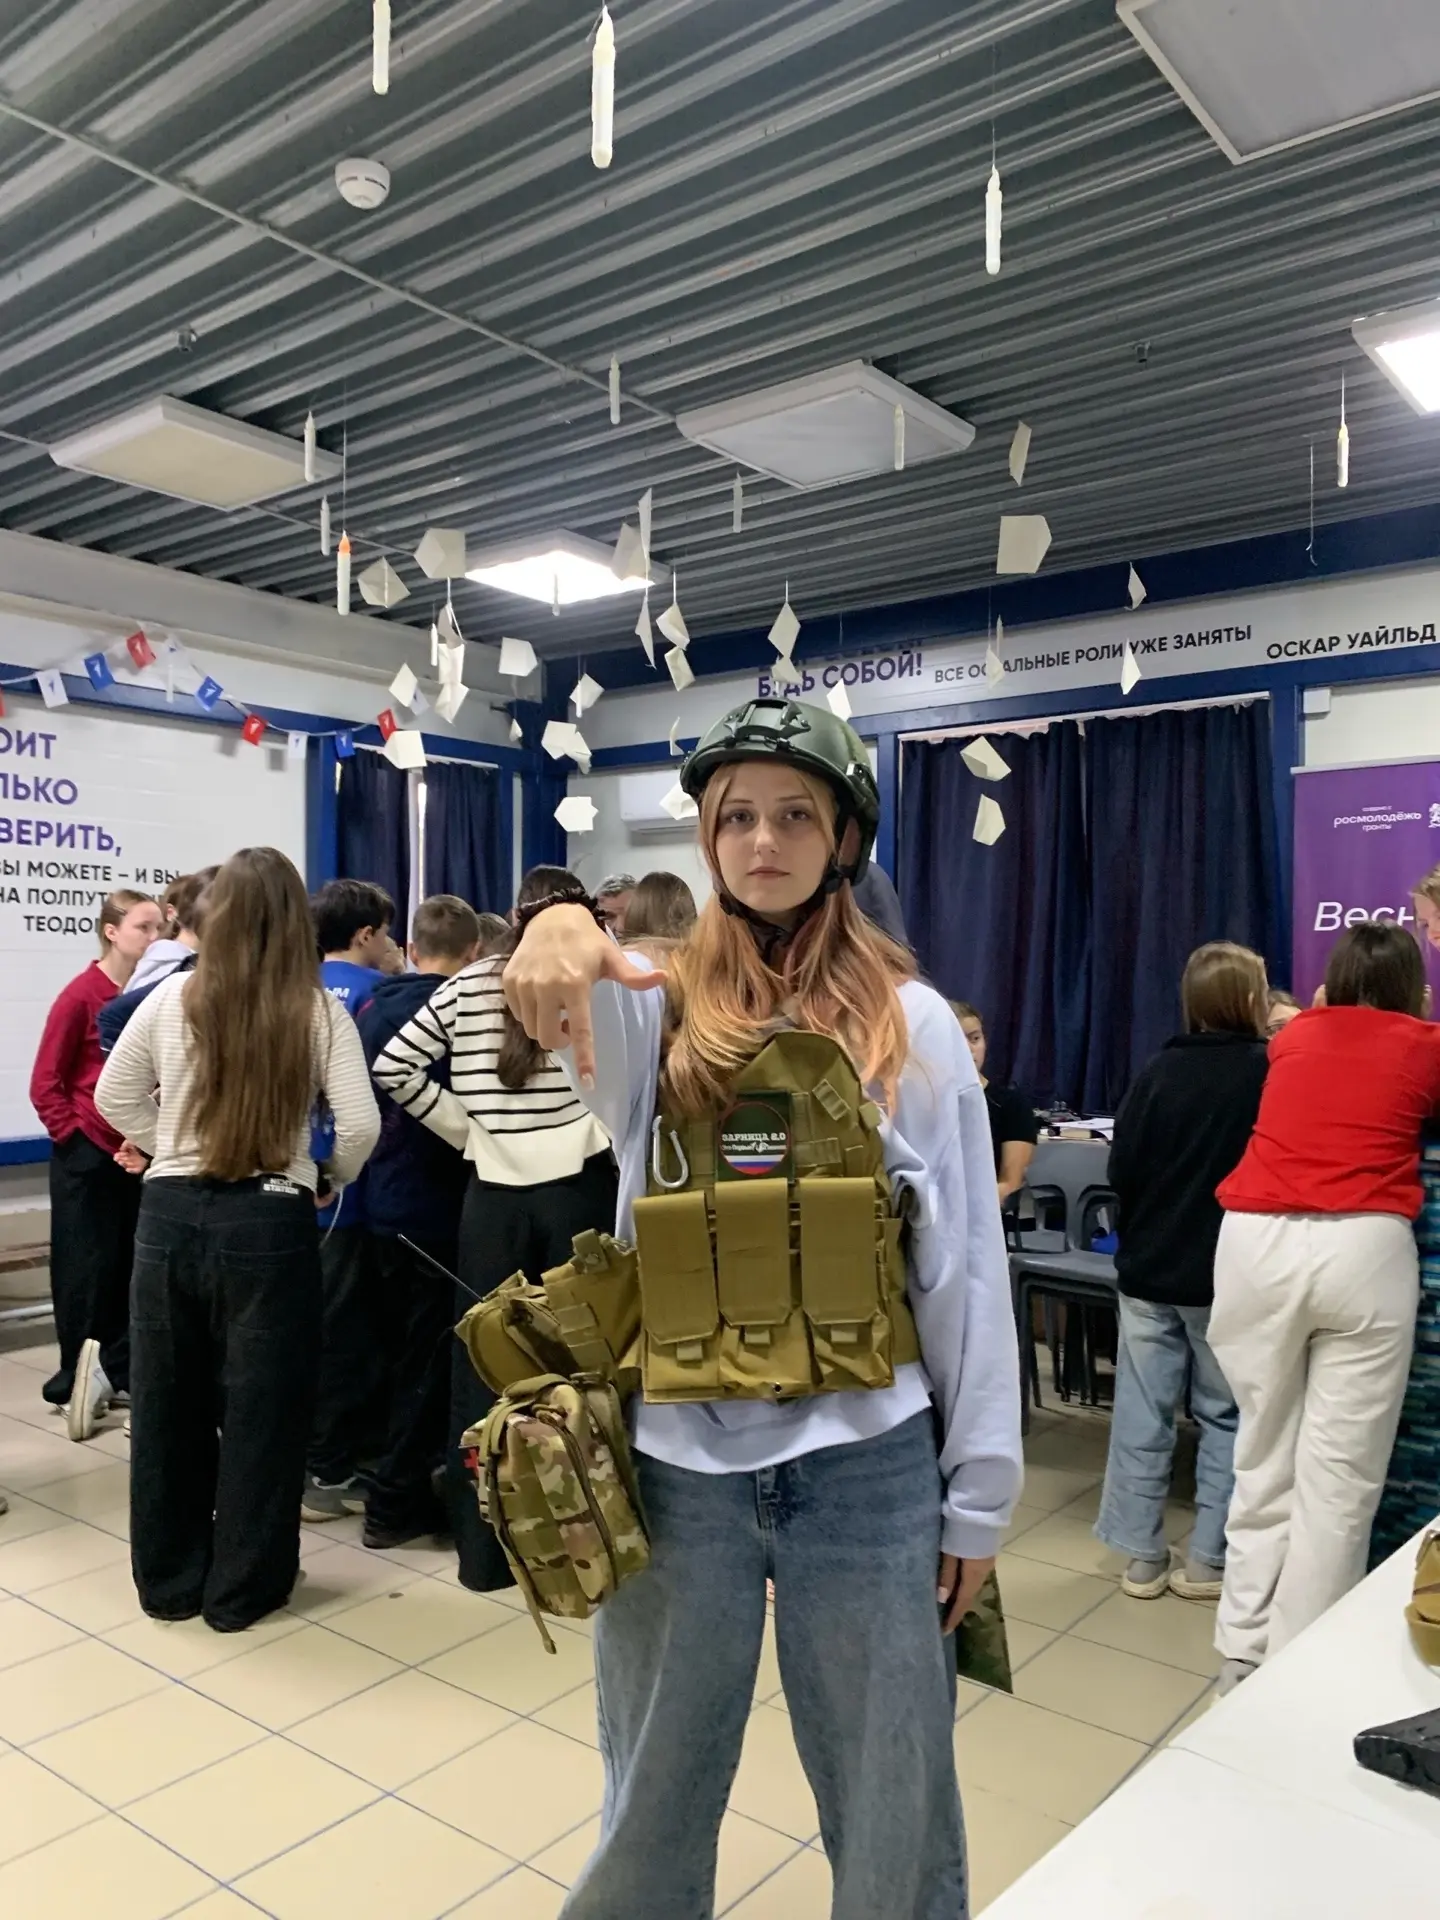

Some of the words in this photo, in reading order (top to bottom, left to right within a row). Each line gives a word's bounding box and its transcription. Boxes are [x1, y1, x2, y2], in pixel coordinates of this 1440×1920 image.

[934, 664, 964, 683] ВСЕ
[968, 650, 1070, 678] ОСАЛЬНЫЕ
[1075, 643, 1123, 664] РОЛИ
[1129, 636, 1168, 655] УЖЕ
[1173, 625, 1252, 650] ЗАНЯТЫ
[1266, 636, 1340, 660] ОСКАР
[1347, 623, 1437, 650] УАЙЛЬД
[758, 670, 815, 698] БДЬ
[822, 649, 922, 689] СОБОЙ!
[0, 817, 122, 857] ВЕРИТЬ,
[27, 860, 113, 881] МОЖЕТЕ
[135, 867, 148, 884] И
